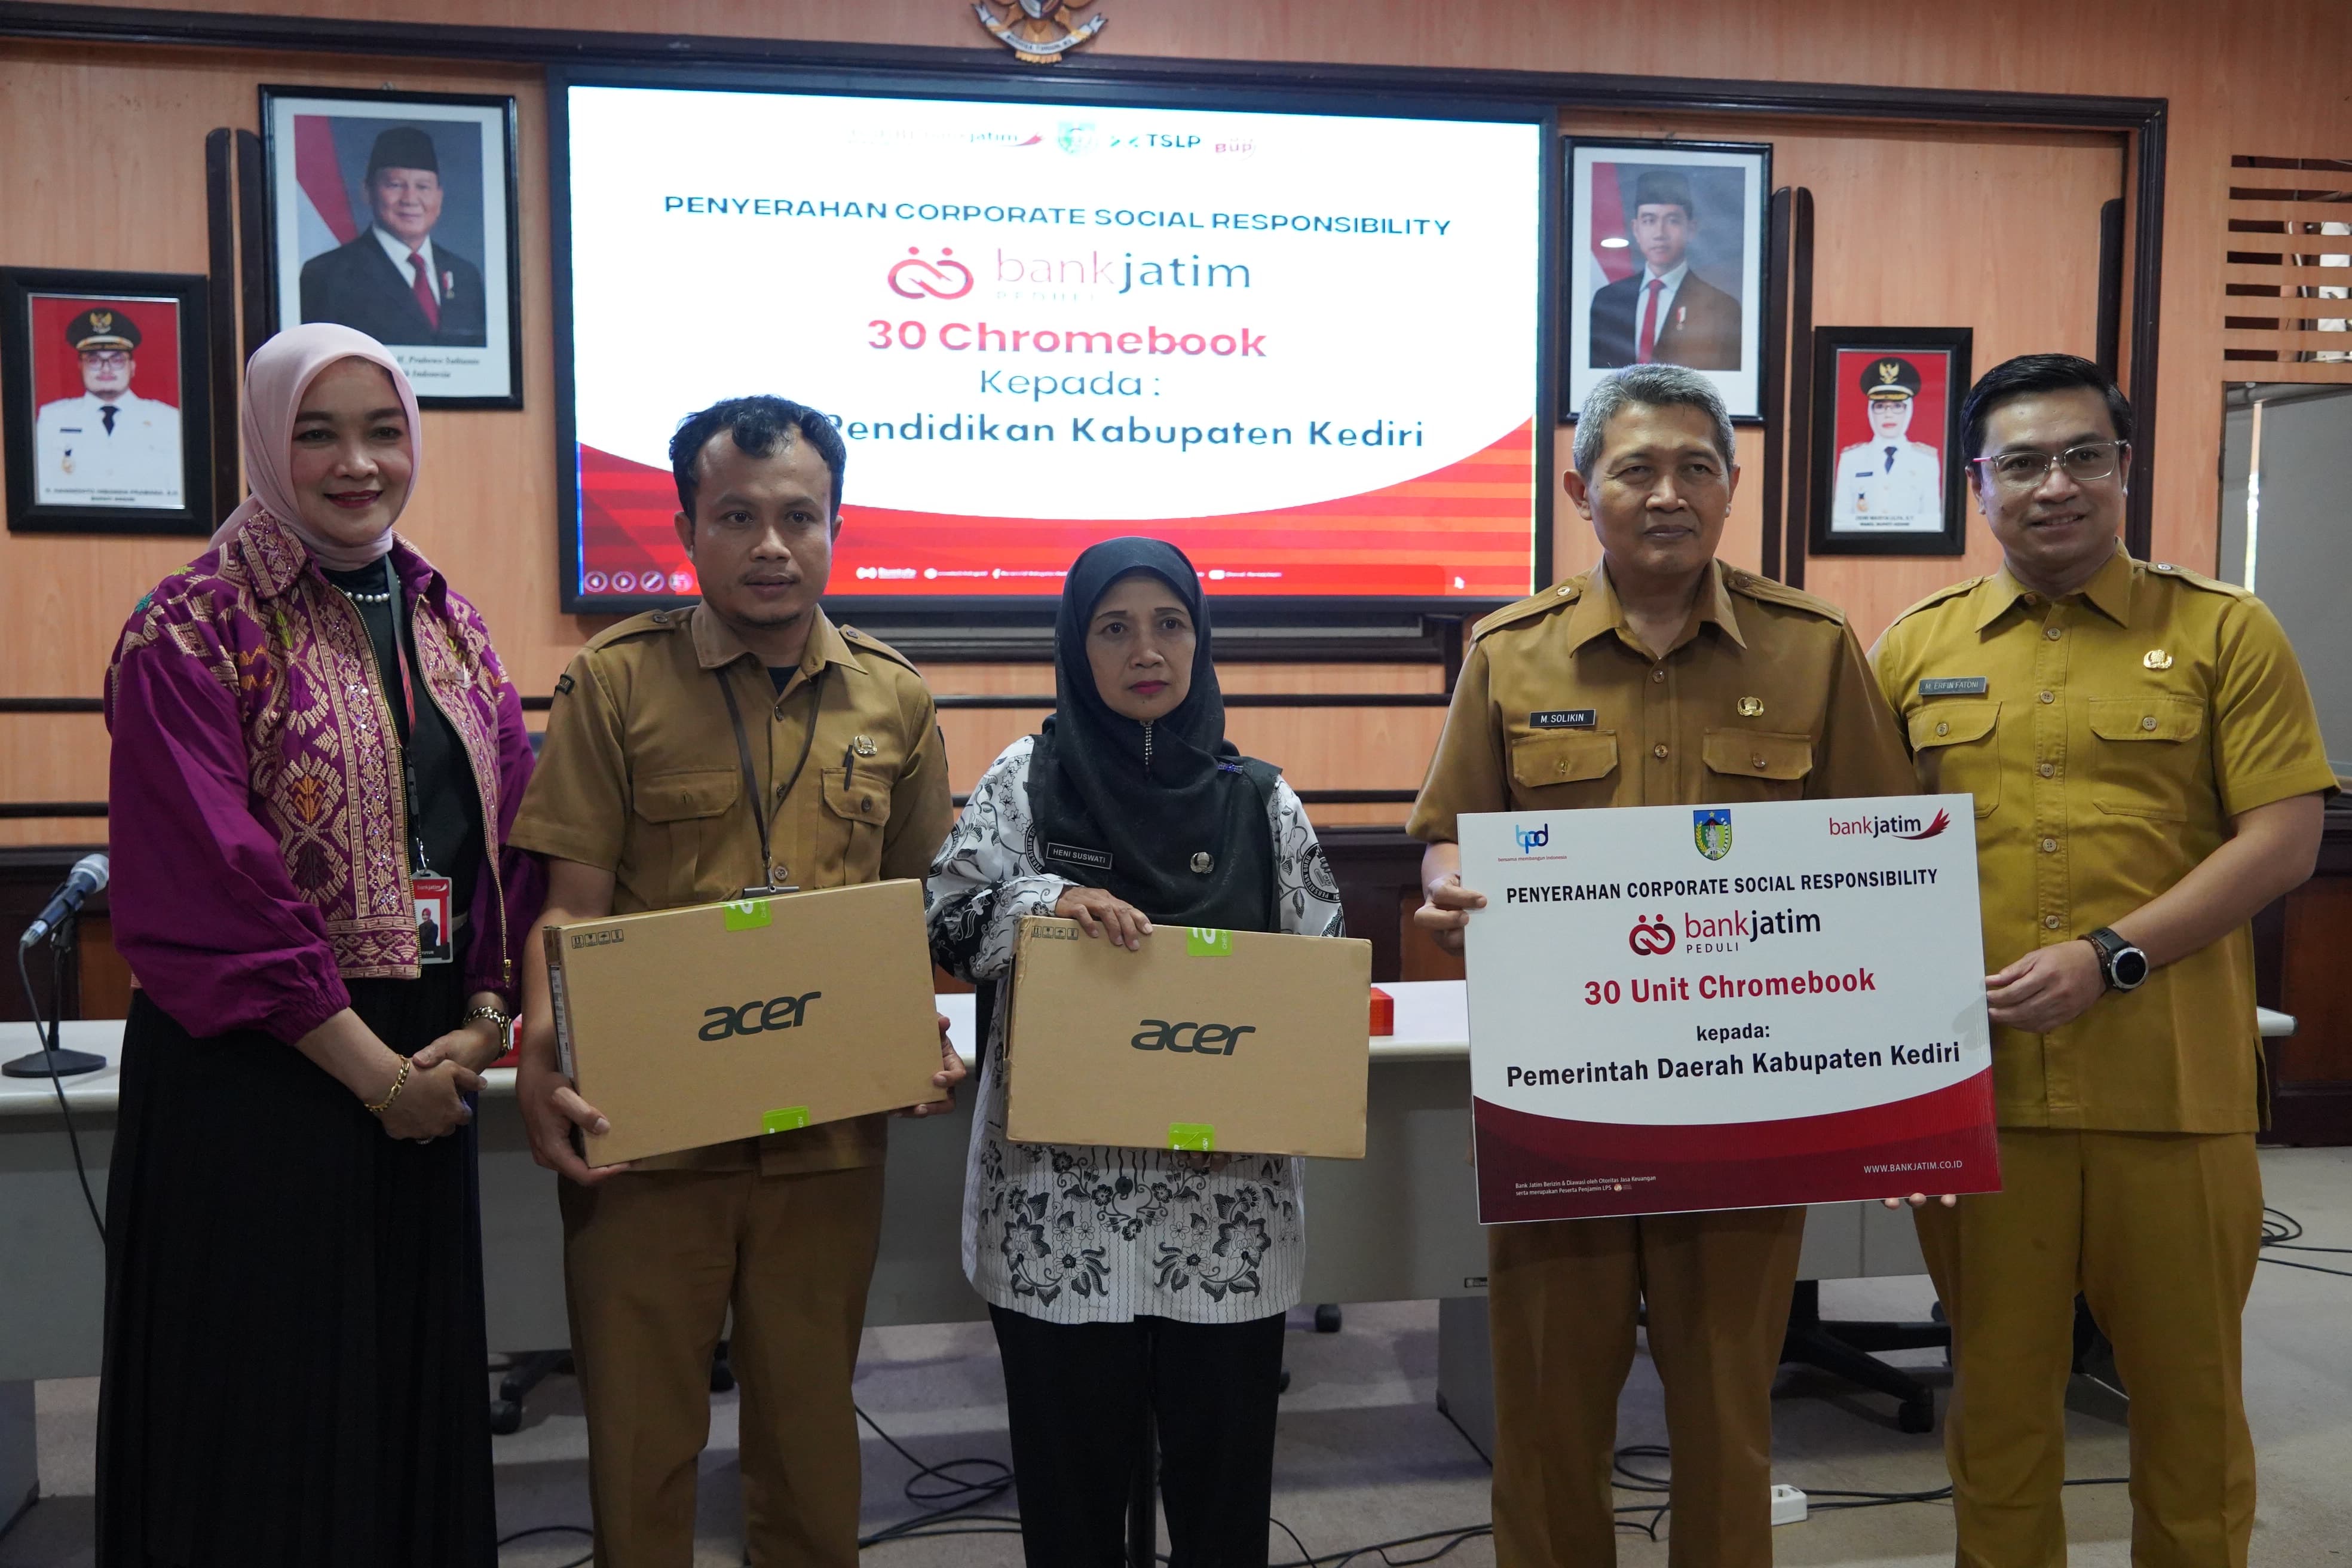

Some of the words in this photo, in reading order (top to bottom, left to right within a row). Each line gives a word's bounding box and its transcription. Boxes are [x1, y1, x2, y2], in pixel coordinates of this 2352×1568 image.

[1147, 133, 1201, 148] TSLP
[665, 196, 887, 219] PENYERAHAN
[895, 203, 1086, 225] CORPORATE
[1094, 209, 1205, 229] SOCIAL
[1212, 213, 1451, 236] RESPONSIBILITY
[997, 248, 1251, 294] bankjatim
[868, 320, 926, 350] 30
[939, 322, 1267, 357] Chromebook
[1072, 416, 1291, 452] Kabupaten
[1309, 419, 1422, 447] Kediri
[1955, 681, 1979, 689] FATONI
[1540, 715, 1549, 724] M.
[1551, 713, 1584, 723] SOLIKIN
[1830, 814, 1922, 838] bankjatim
[1053, 848, 1071, 858] HENI
[1073, 852, 1106, 863] SUSWATI
[1506, 883, 1621, 904] PENYERAHAN
[1627, 877, 1729, 899] CORPORATE
[1734, 875, 1796, 893] SOCIAL
[1800, 868, 1938, 890] RESPONSIBILITY
[1685, 908, 1821, 942] bankjatim
[1686, 942, 1738, 954] PEDULI
[1585, 980, 1621, 1005] 30
[1631, 976, 1690, 1003] Unit
[1699, 967, 1876, 999] Chromebook
[699, 991, 822, 1041] acer
[1696, 1022, 1770, 1044] kepada:
[1131, 1019, 1256, 1055] acer
[1507, 1059, 1649, 1087] Pemerintah
[1658, 1054, 1744, 1079] Daerah
[1752, 1049, 1882, 1075] Kabupaten
[1891, 1041, 1960, 1066] Kediri
[1863, 1160, 1963, 1174] WWW.BANKJATIM.CO.ID
